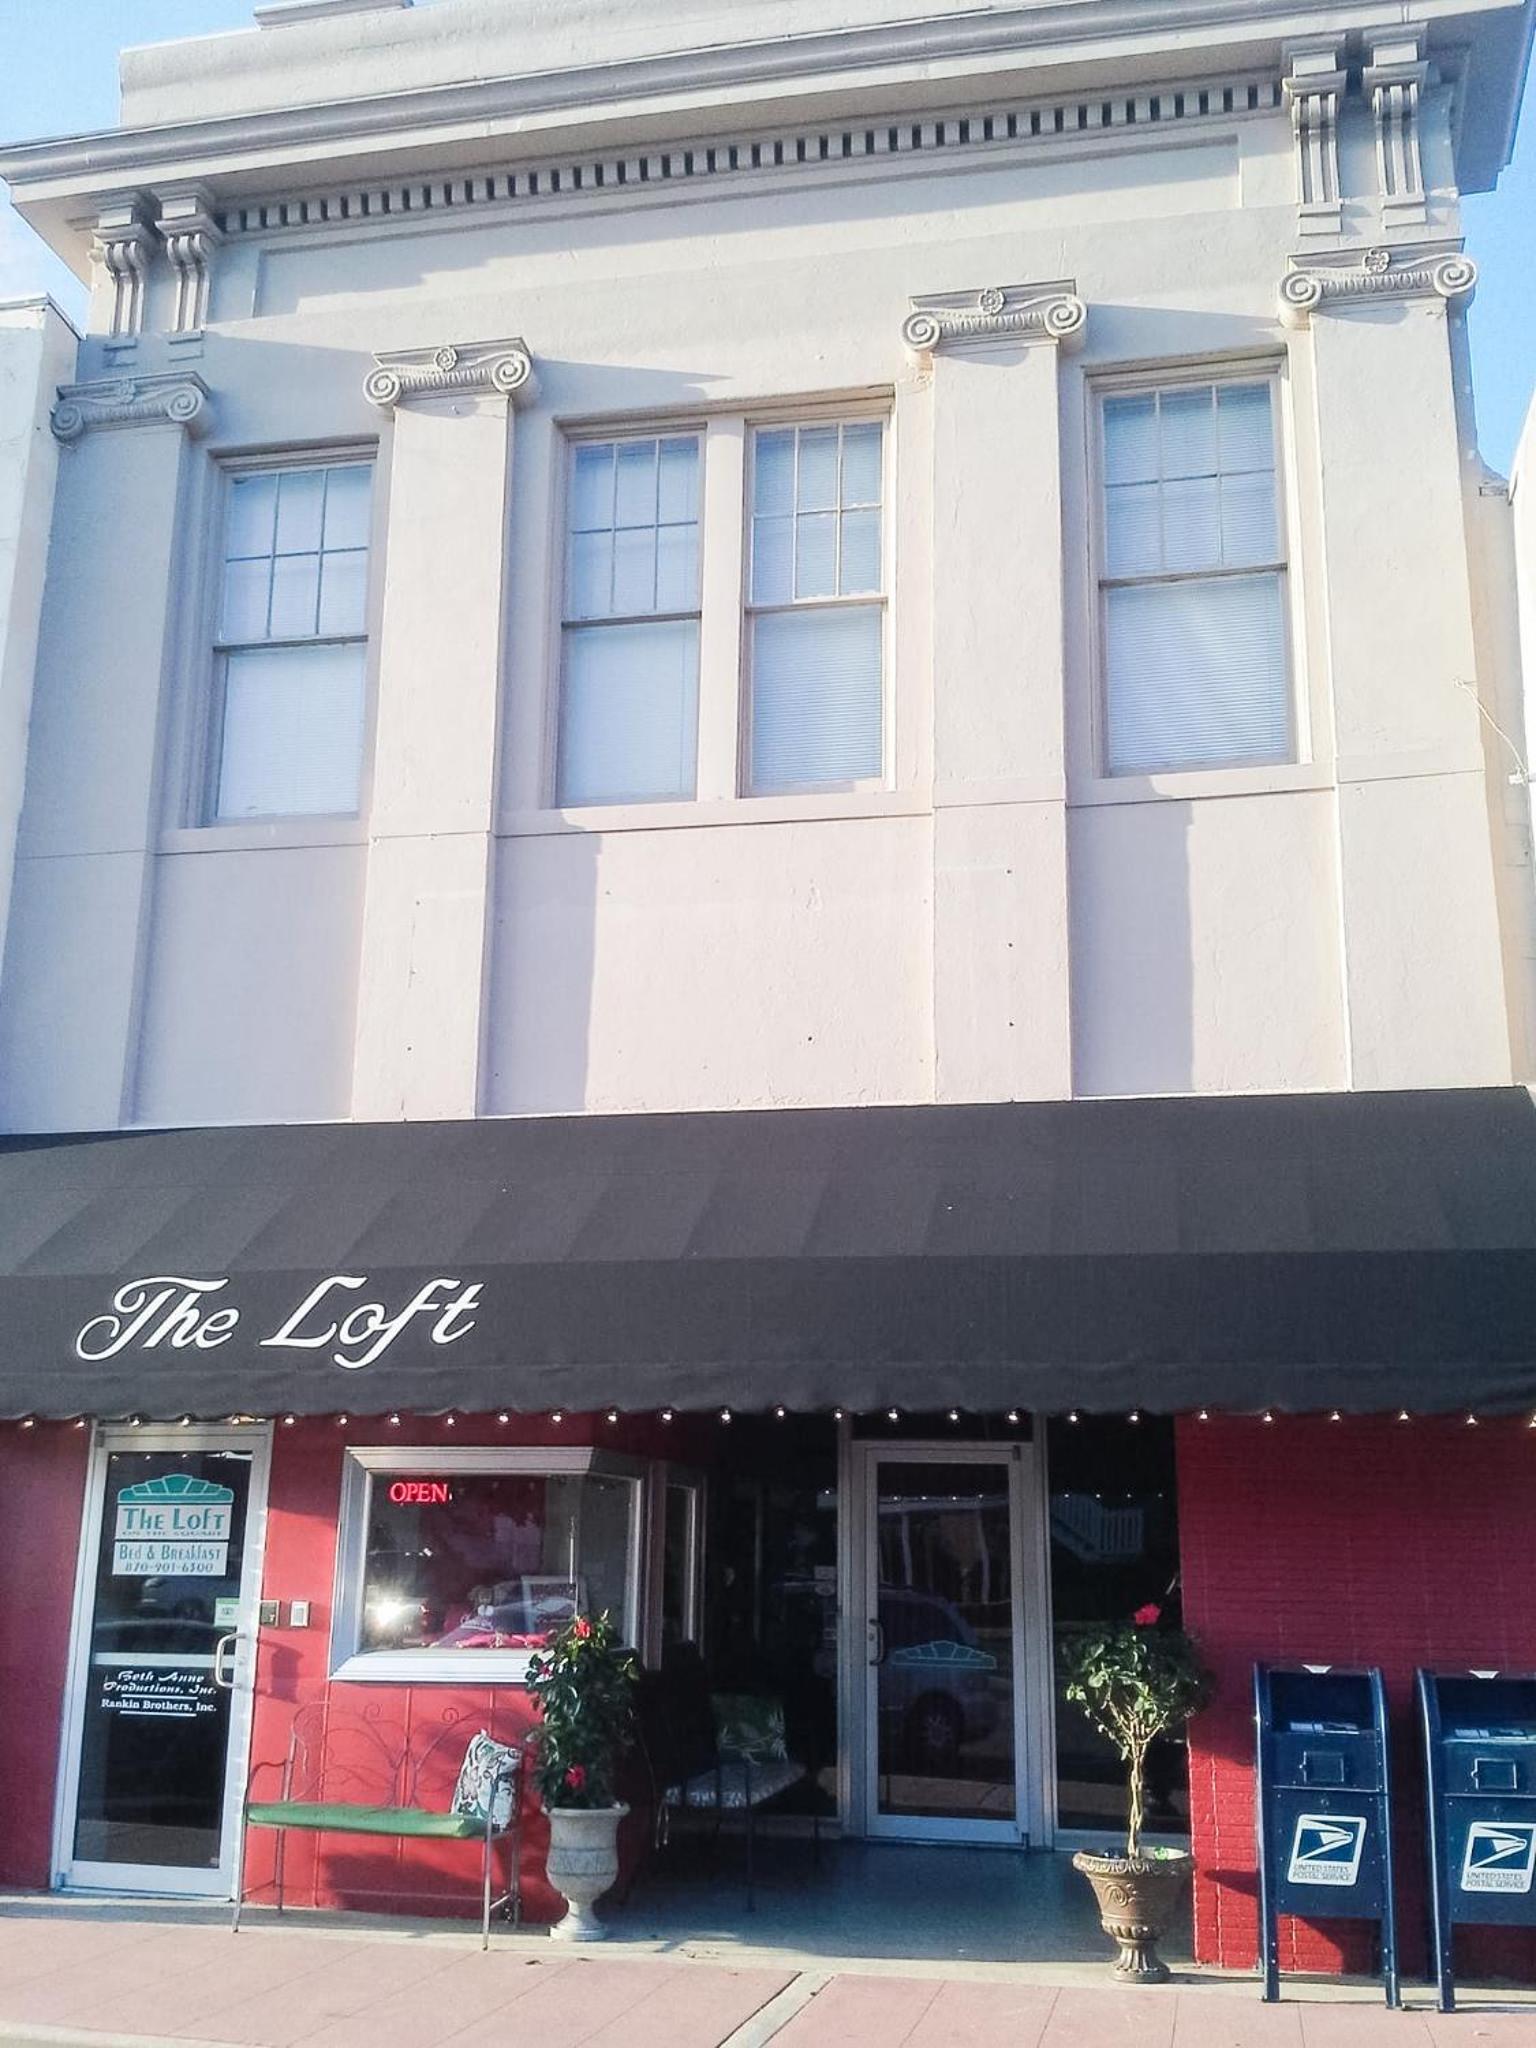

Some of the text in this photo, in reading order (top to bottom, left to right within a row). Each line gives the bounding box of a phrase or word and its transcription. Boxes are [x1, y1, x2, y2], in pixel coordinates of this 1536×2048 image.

[75, 1276, 485, 1368] The Loft
[390, 1482, 448, 1502] OPEN
[146, 1545, 155, 1560] &
[118, 1671, 154, 1682] Beth
[101, 1699, 140, 1708] Rankin
[196, 1701, 217, 1712] Inc.
